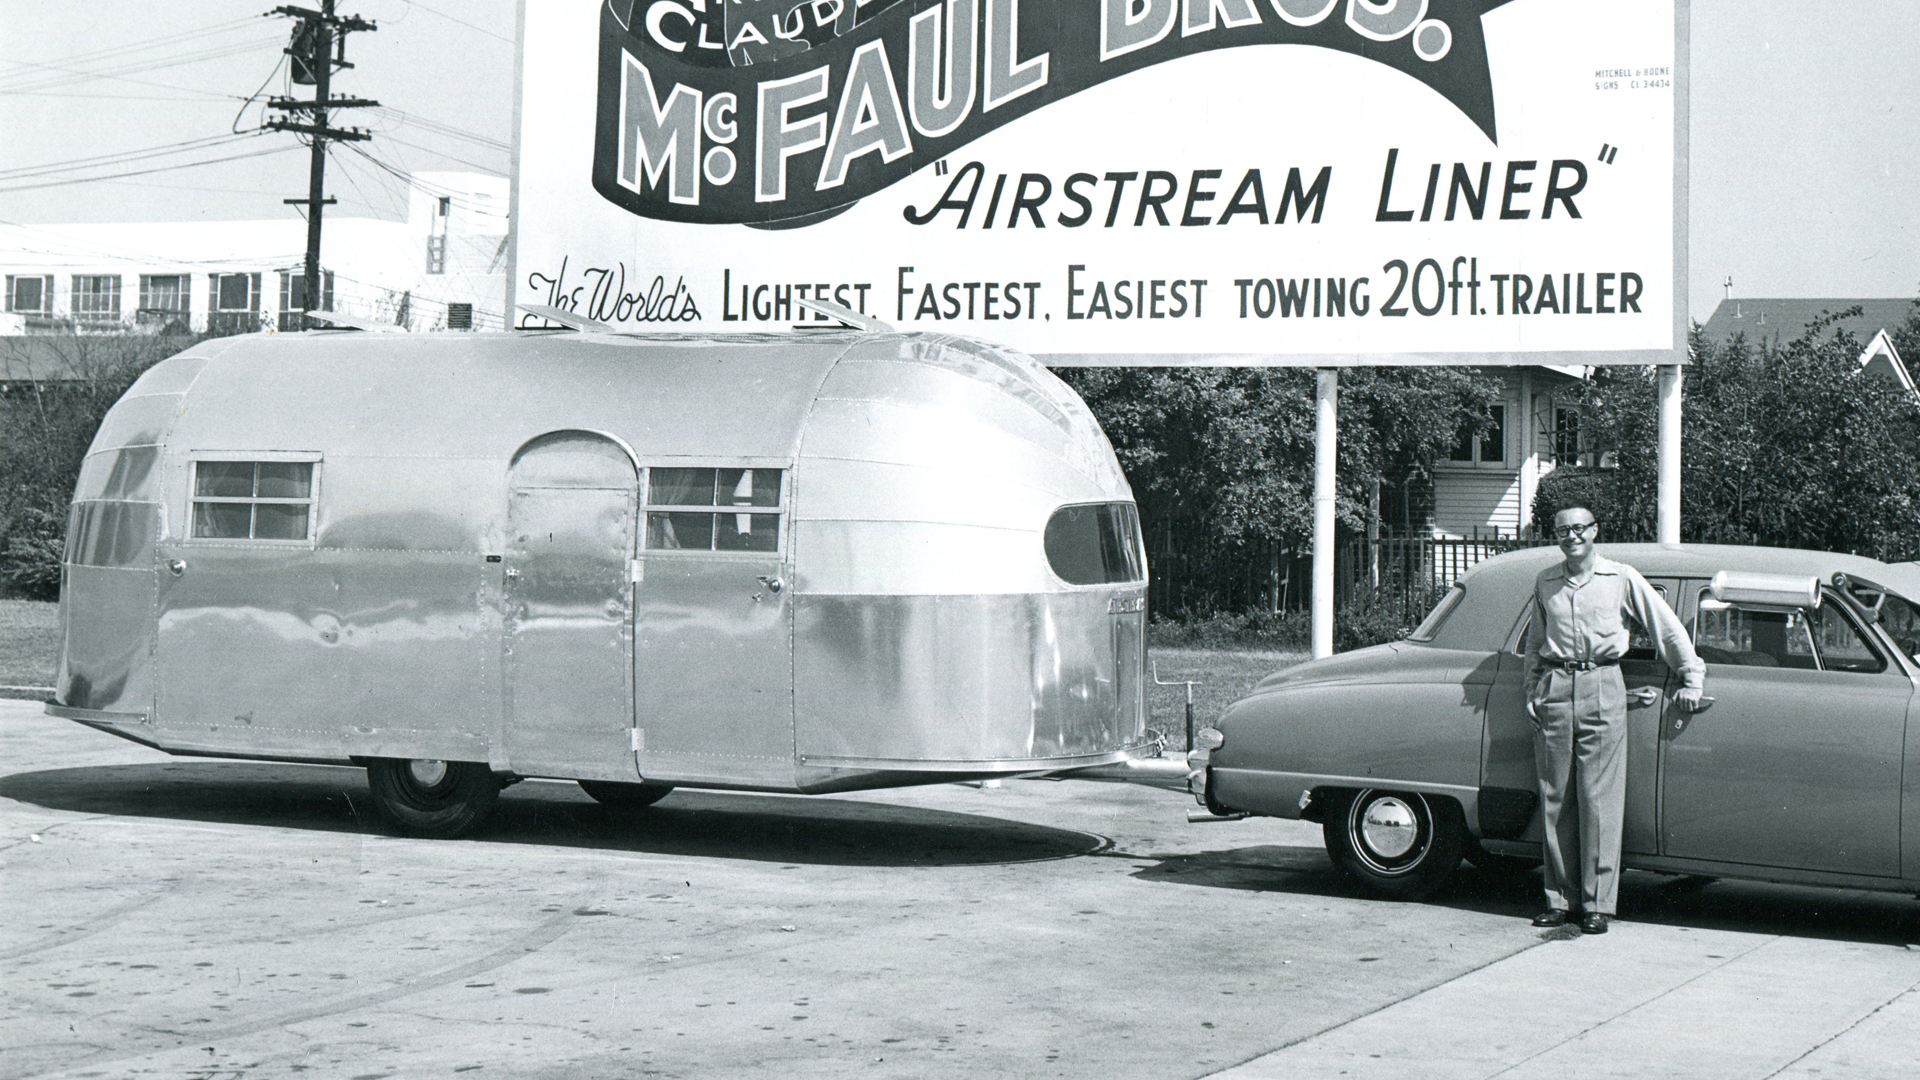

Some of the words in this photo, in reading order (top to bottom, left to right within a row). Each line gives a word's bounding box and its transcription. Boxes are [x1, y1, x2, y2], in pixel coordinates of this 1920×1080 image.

[646, 0, 869, 52] CLAUD
[1595, 68, 1632, 78] MITCHELL
[1644, 66, 1670, 76] BOONE
[1595, 81, 1619, 91] SIGNS
[584, 261, 702, 323] World's
[1067, 264, 1208, 320] EASIEST
[1234, 277, 1370, 319] TOWING
[1490, 272, 1643, 316] TRAILER
